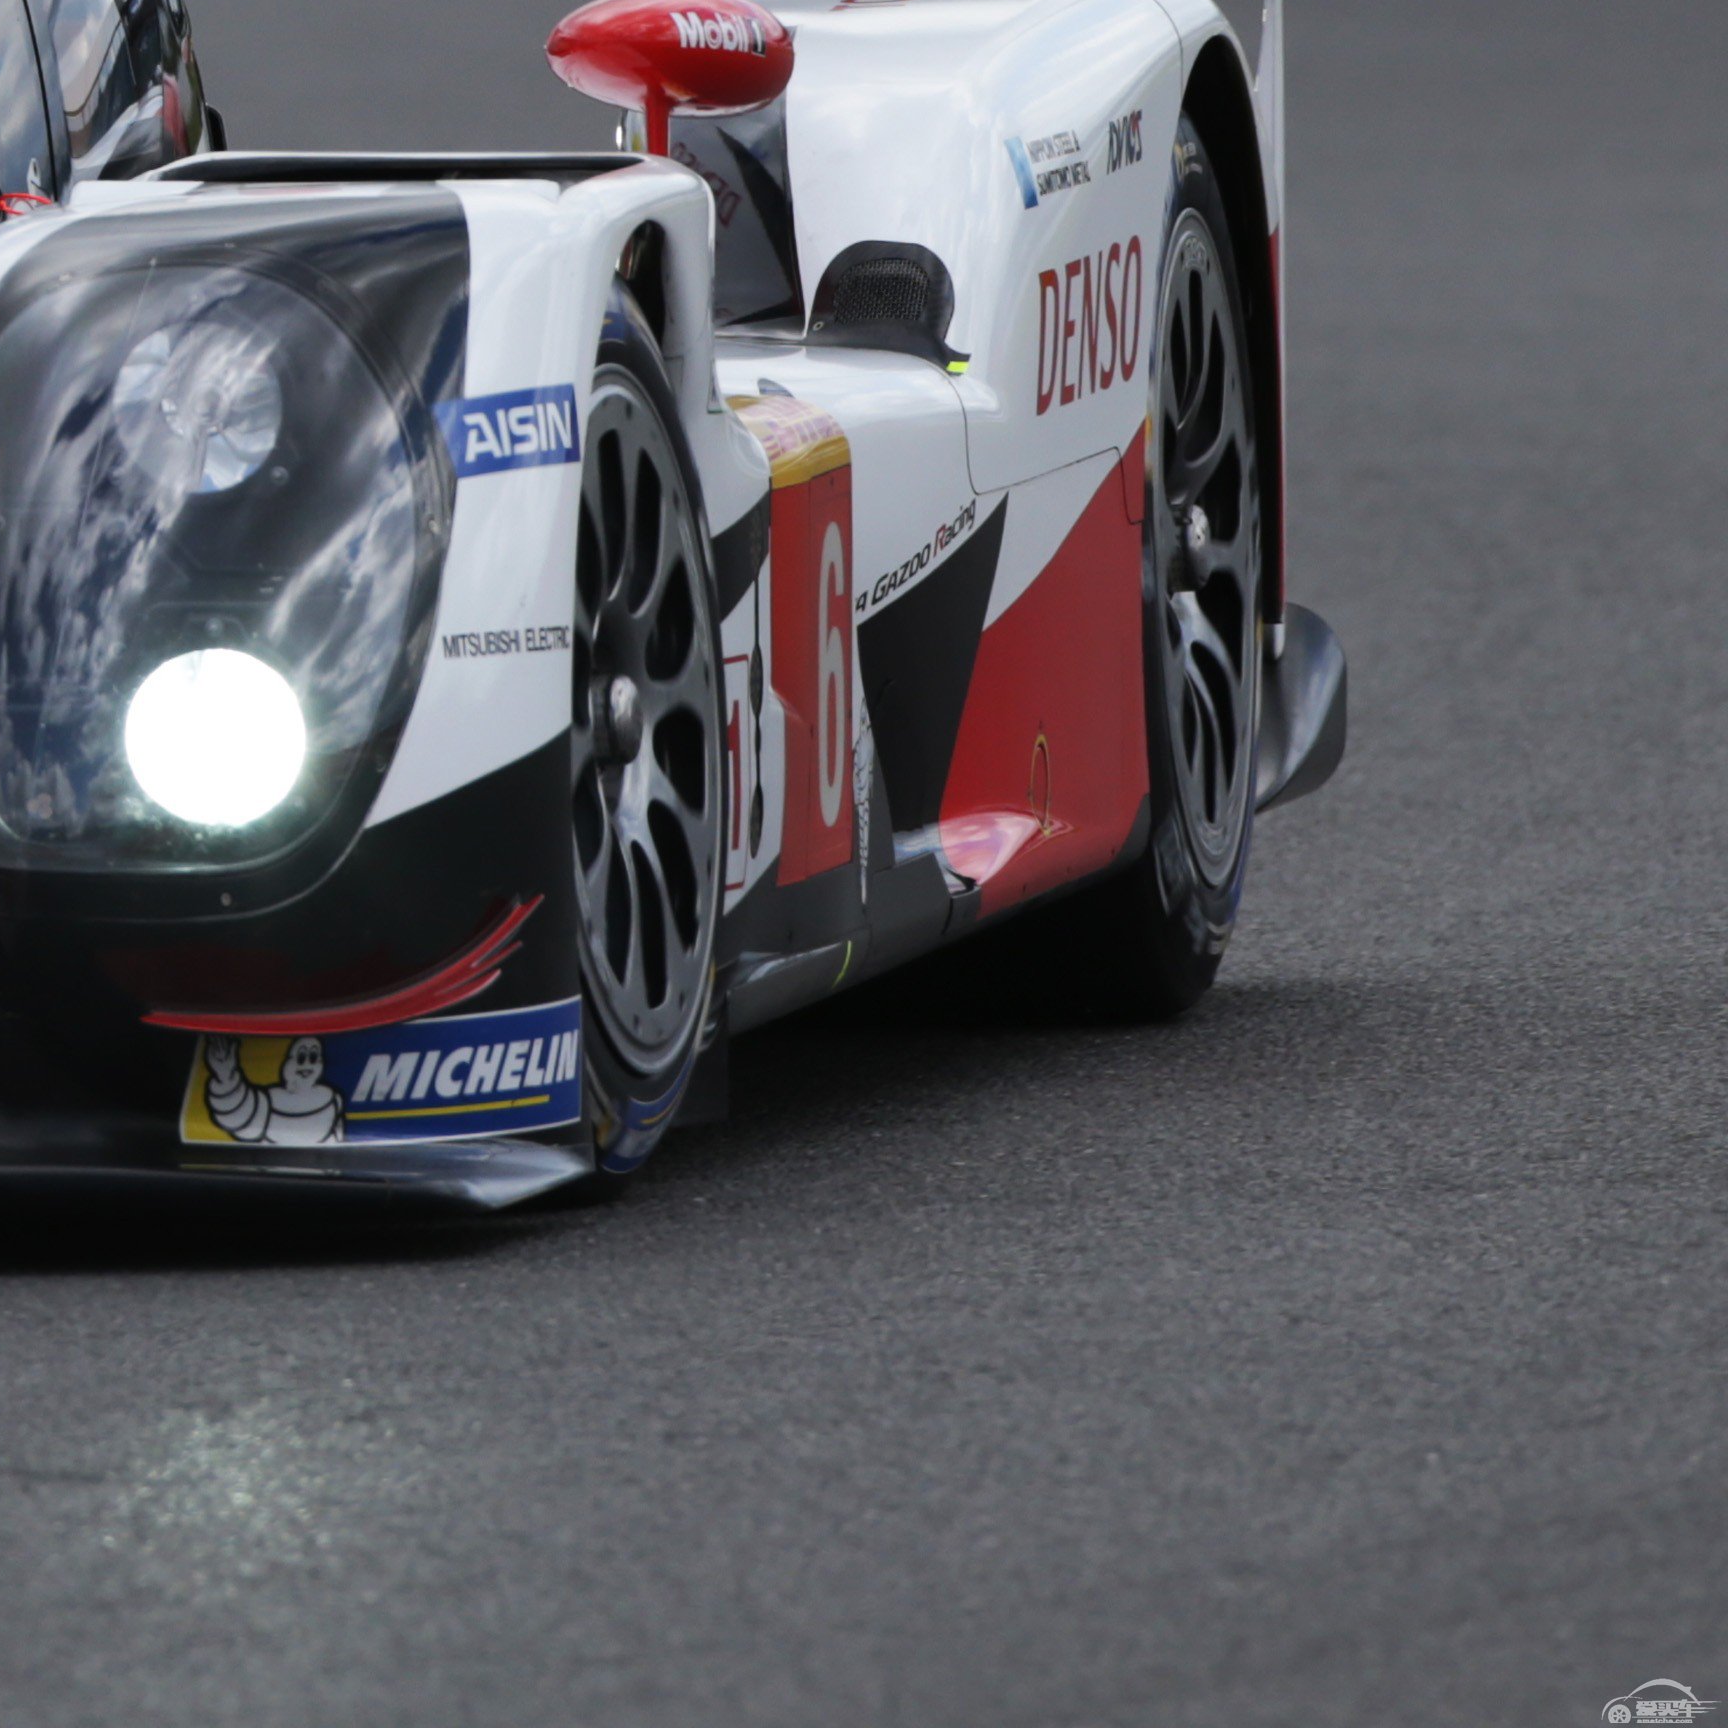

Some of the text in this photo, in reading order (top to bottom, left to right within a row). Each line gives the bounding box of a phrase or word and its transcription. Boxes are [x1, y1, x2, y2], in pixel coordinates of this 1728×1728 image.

[670, 11, 750, 54] Mobil
[1035, 234, 1142, 417] DENSO
[462, 400, 573, 463] AISIN
[870, 543, 932, 606] GAZOO
[932, 497, 977, 560] Racing
[442, 625, 572, 659] MITSUBISHI ELECTRIC
[818, 520, 845, 828] 6
[351, 1028, 580, 1103] MICHELIN
